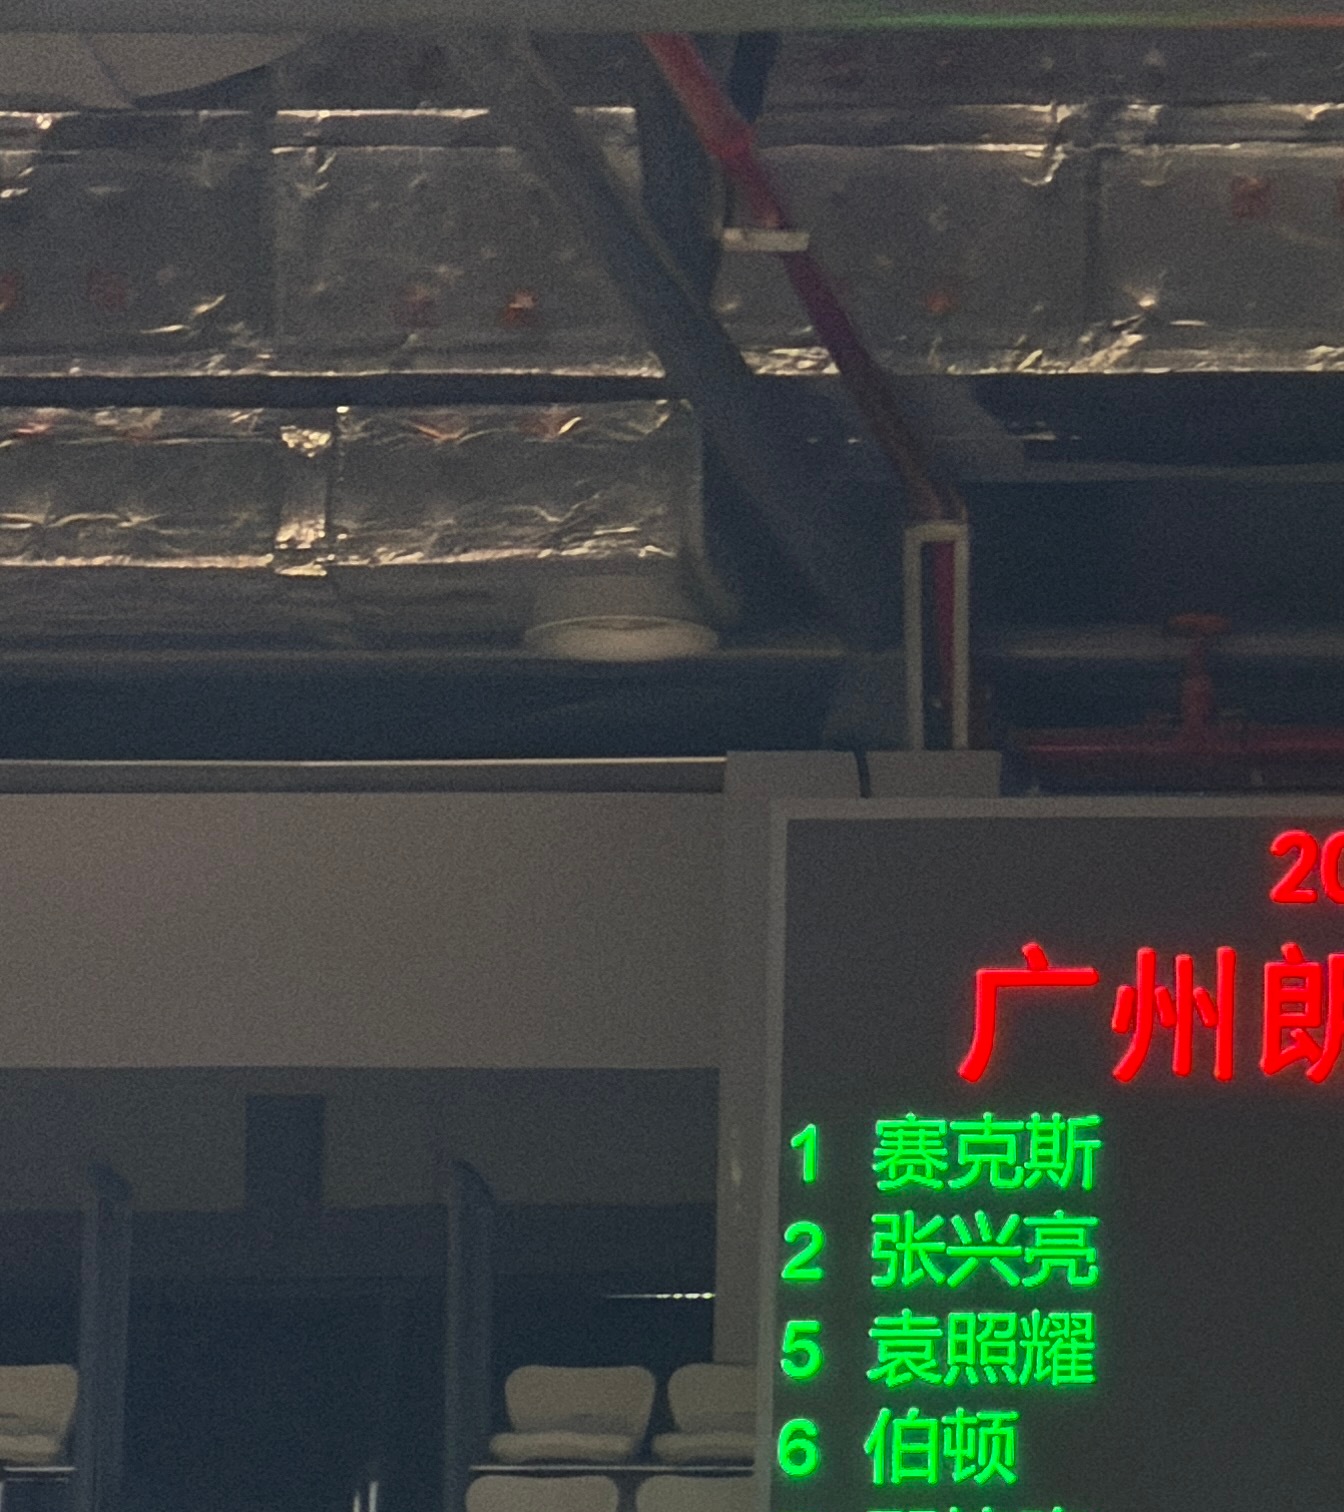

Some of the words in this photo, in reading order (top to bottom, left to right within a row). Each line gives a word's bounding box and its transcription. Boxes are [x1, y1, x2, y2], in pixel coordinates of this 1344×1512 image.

[791, 1124, 818, 1183] 1
[872, 1112, 1102, 1191] 赛克斯
[781, 1221, 824, 1283] 2
[871, 1210, 1099, 1288] 张兴亮
[780, 1320, 824, 1380] 5
[866, 1308, 1095, 1388] 袁照耀
[777, 1418, 820, 1479] 6
[864, 1407, 1019, 1485] 伯顿
